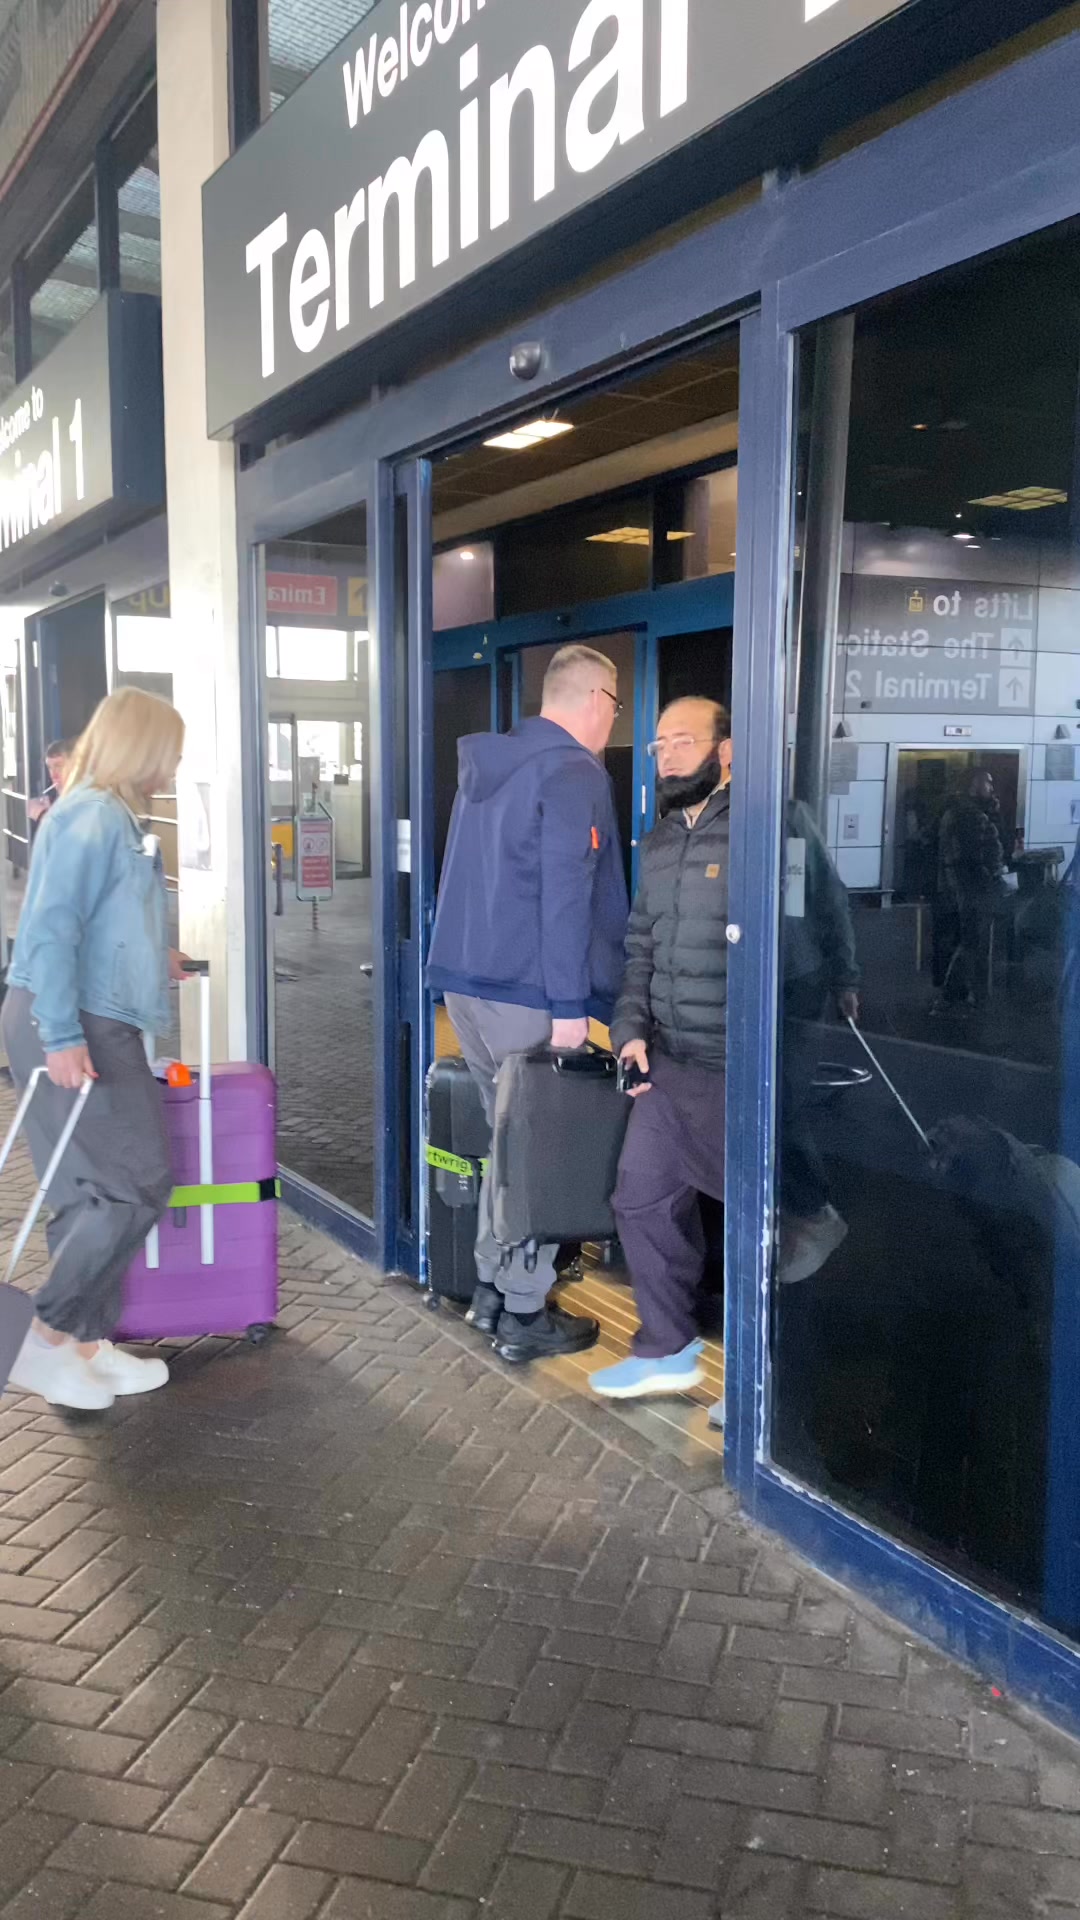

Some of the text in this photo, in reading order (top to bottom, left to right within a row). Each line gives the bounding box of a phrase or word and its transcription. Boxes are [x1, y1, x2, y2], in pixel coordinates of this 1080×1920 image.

[342, 0, 486, 129] Welco
[31, 385, 44, 421] to
[69, 398, 85, 500] 1
